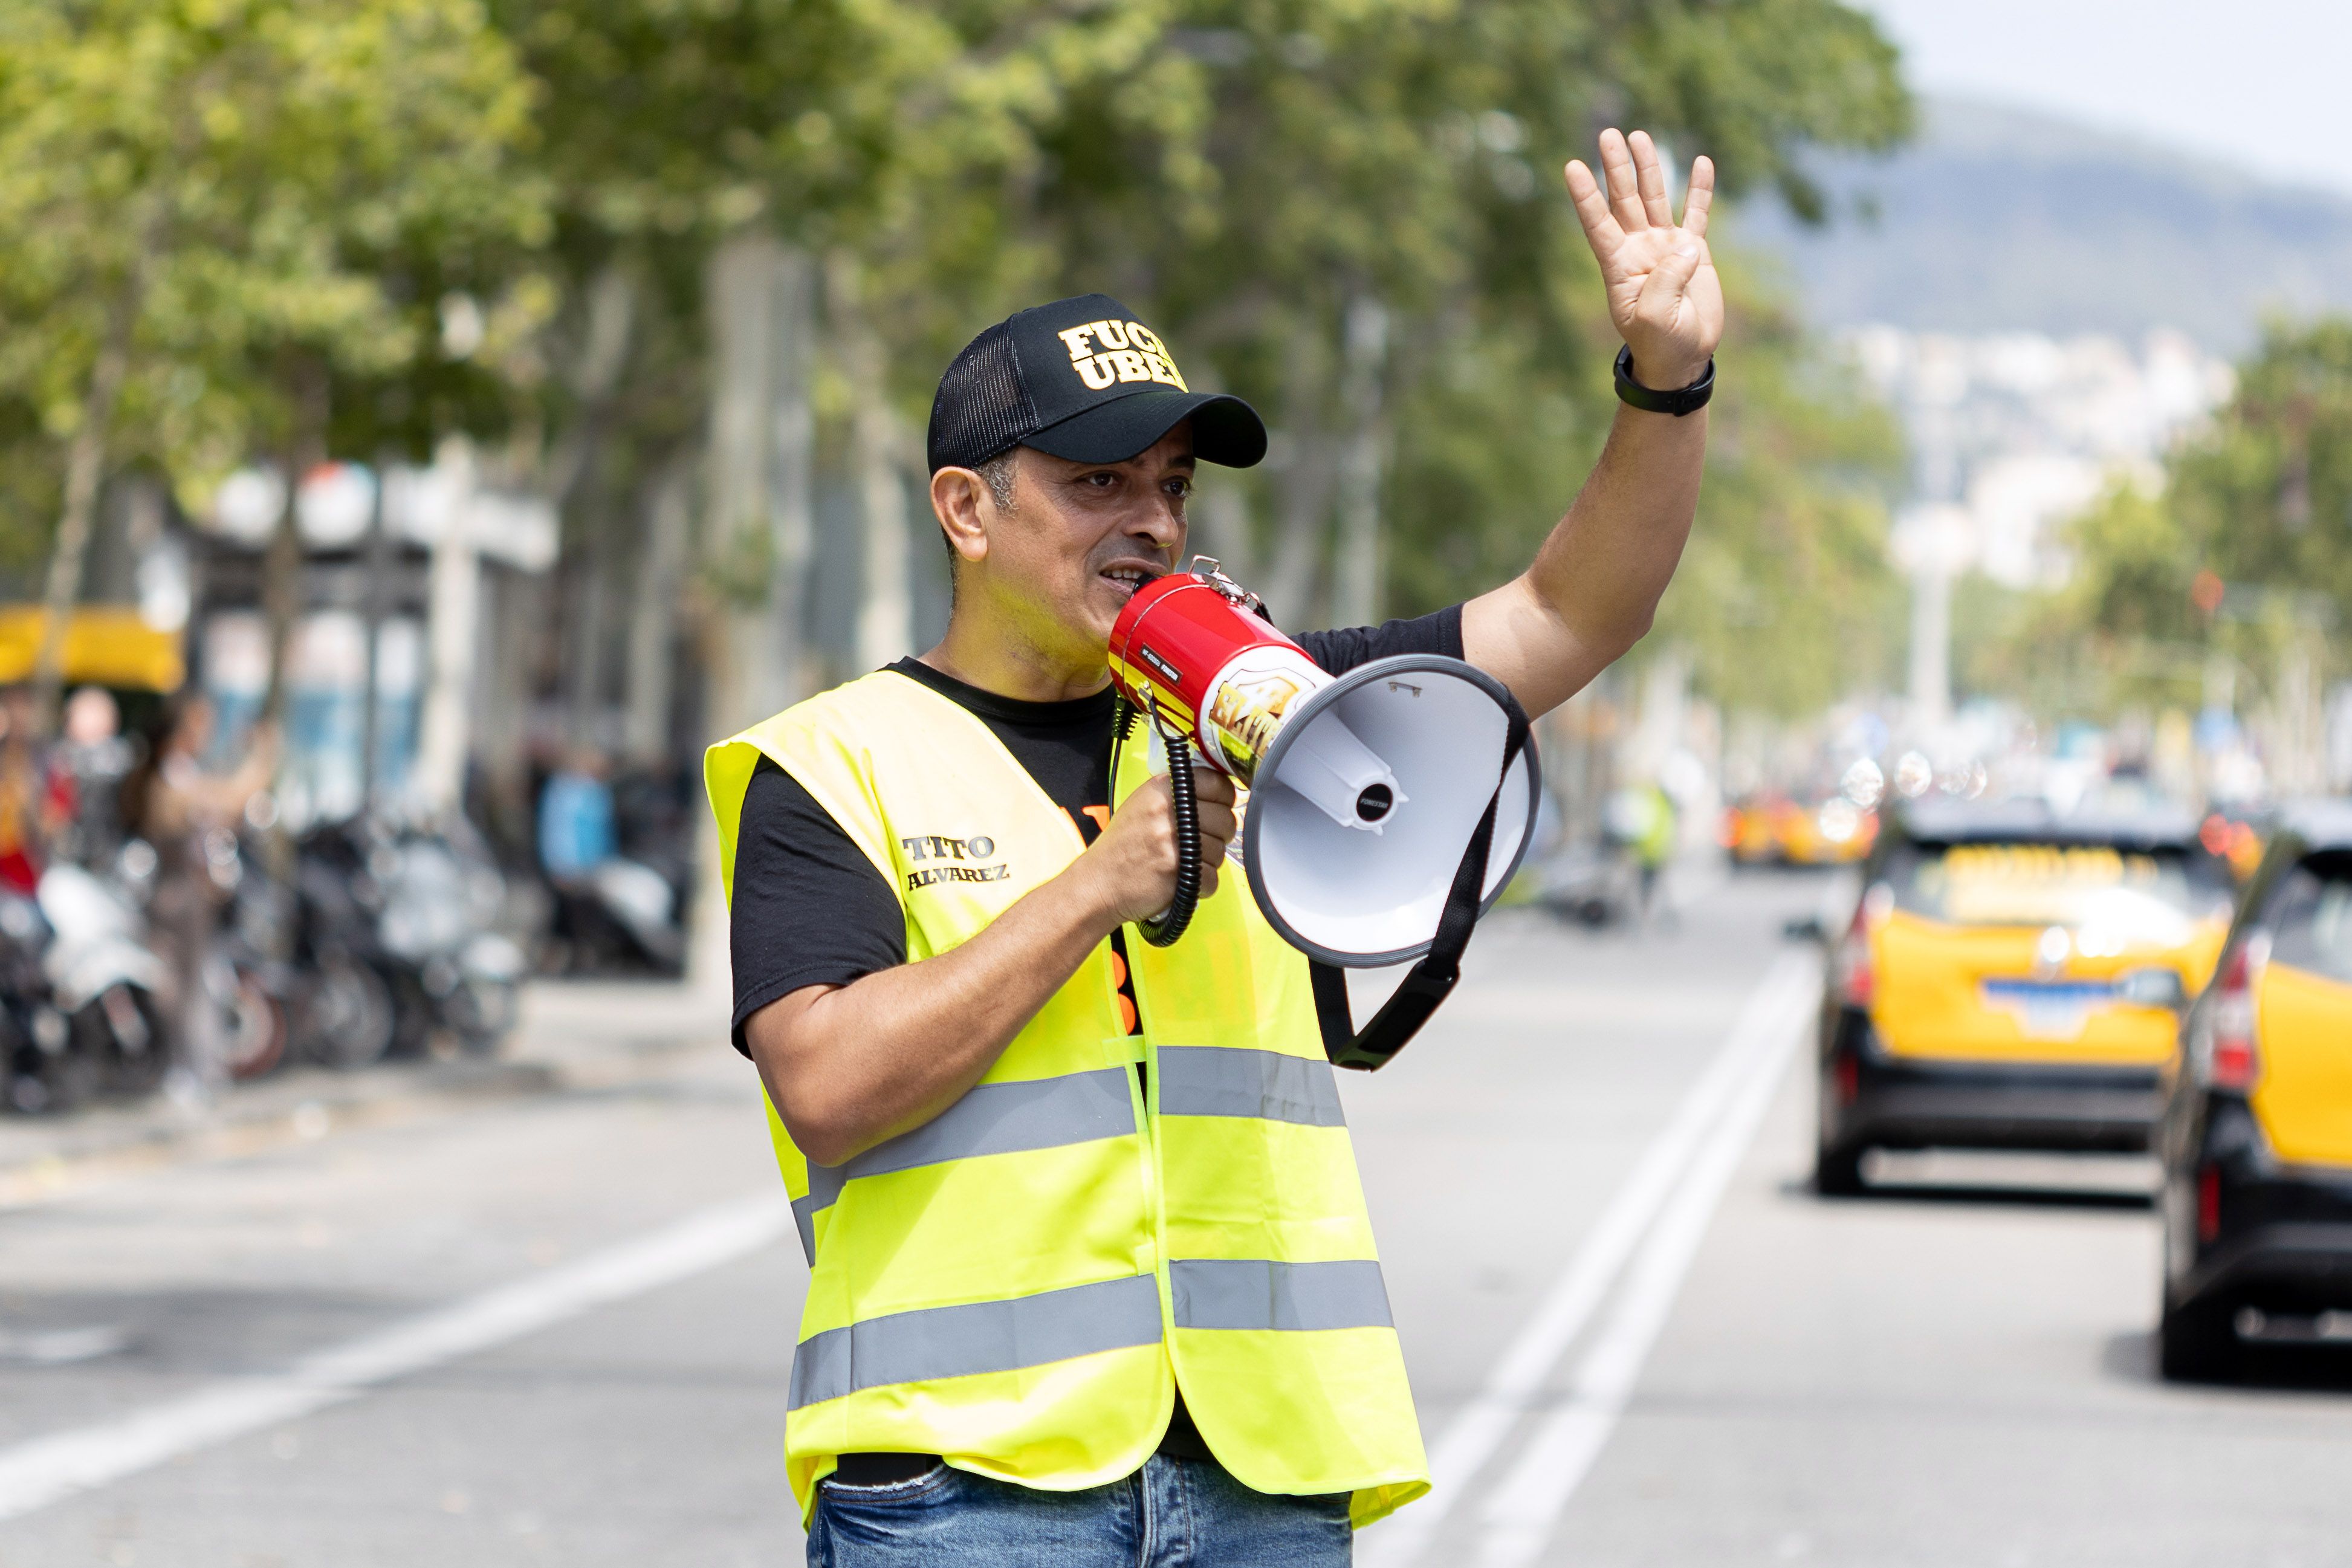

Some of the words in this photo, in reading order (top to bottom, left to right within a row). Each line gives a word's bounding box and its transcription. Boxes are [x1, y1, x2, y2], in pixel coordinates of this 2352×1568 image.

[1360, 798, 1388, 809] FONESTAR
[902, 836, 995, 861] TITO
[907, 864, 1010, 892] ALVAREZ
